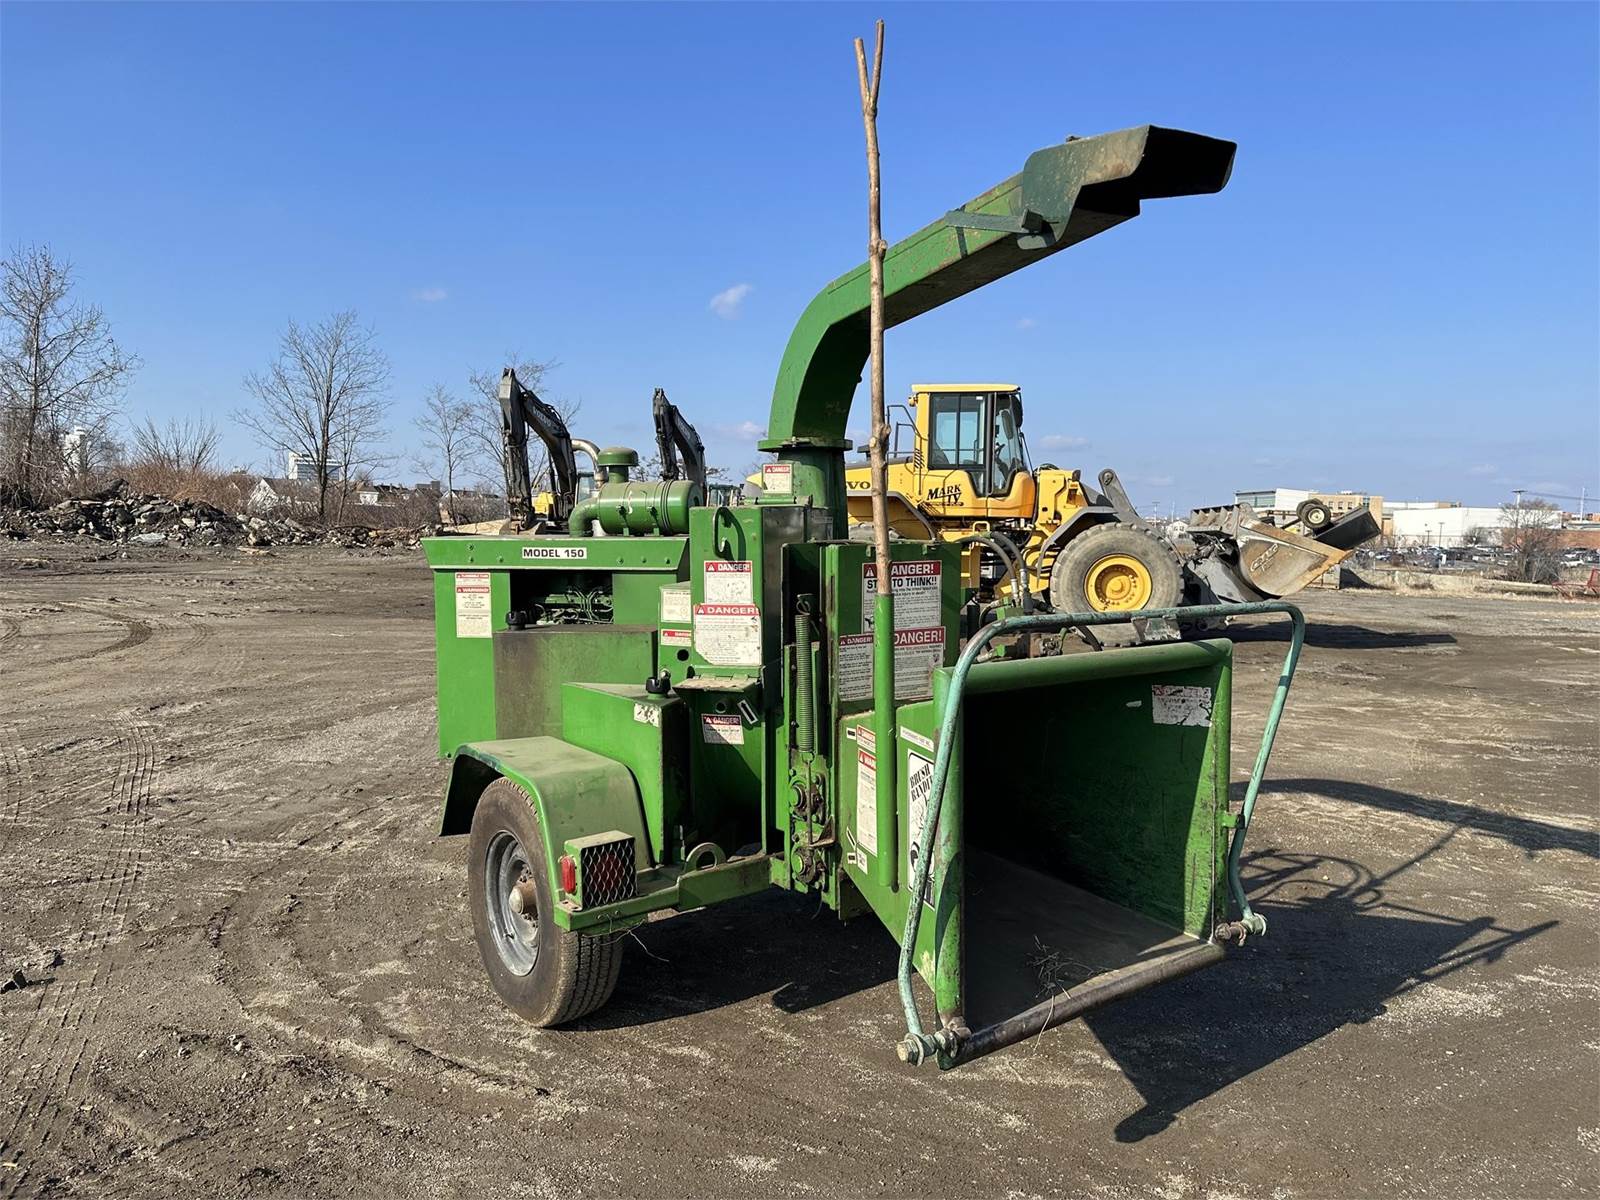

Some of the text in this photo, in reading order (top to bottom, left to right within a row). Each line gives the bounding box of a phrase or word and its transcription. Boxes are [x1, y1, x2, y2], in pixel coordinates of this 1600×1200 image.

[847, 480, 871, 490] VO
[926, 483, 962, 501] MARK
[523, 548, 585, 558] MODEL 150
[717, 563, 750, 571] DANGER!
[891, 563, 934, 576] ANGER!
[892, 578, 904, 588] TO
[906, 576, 937, 587] THINK!!
